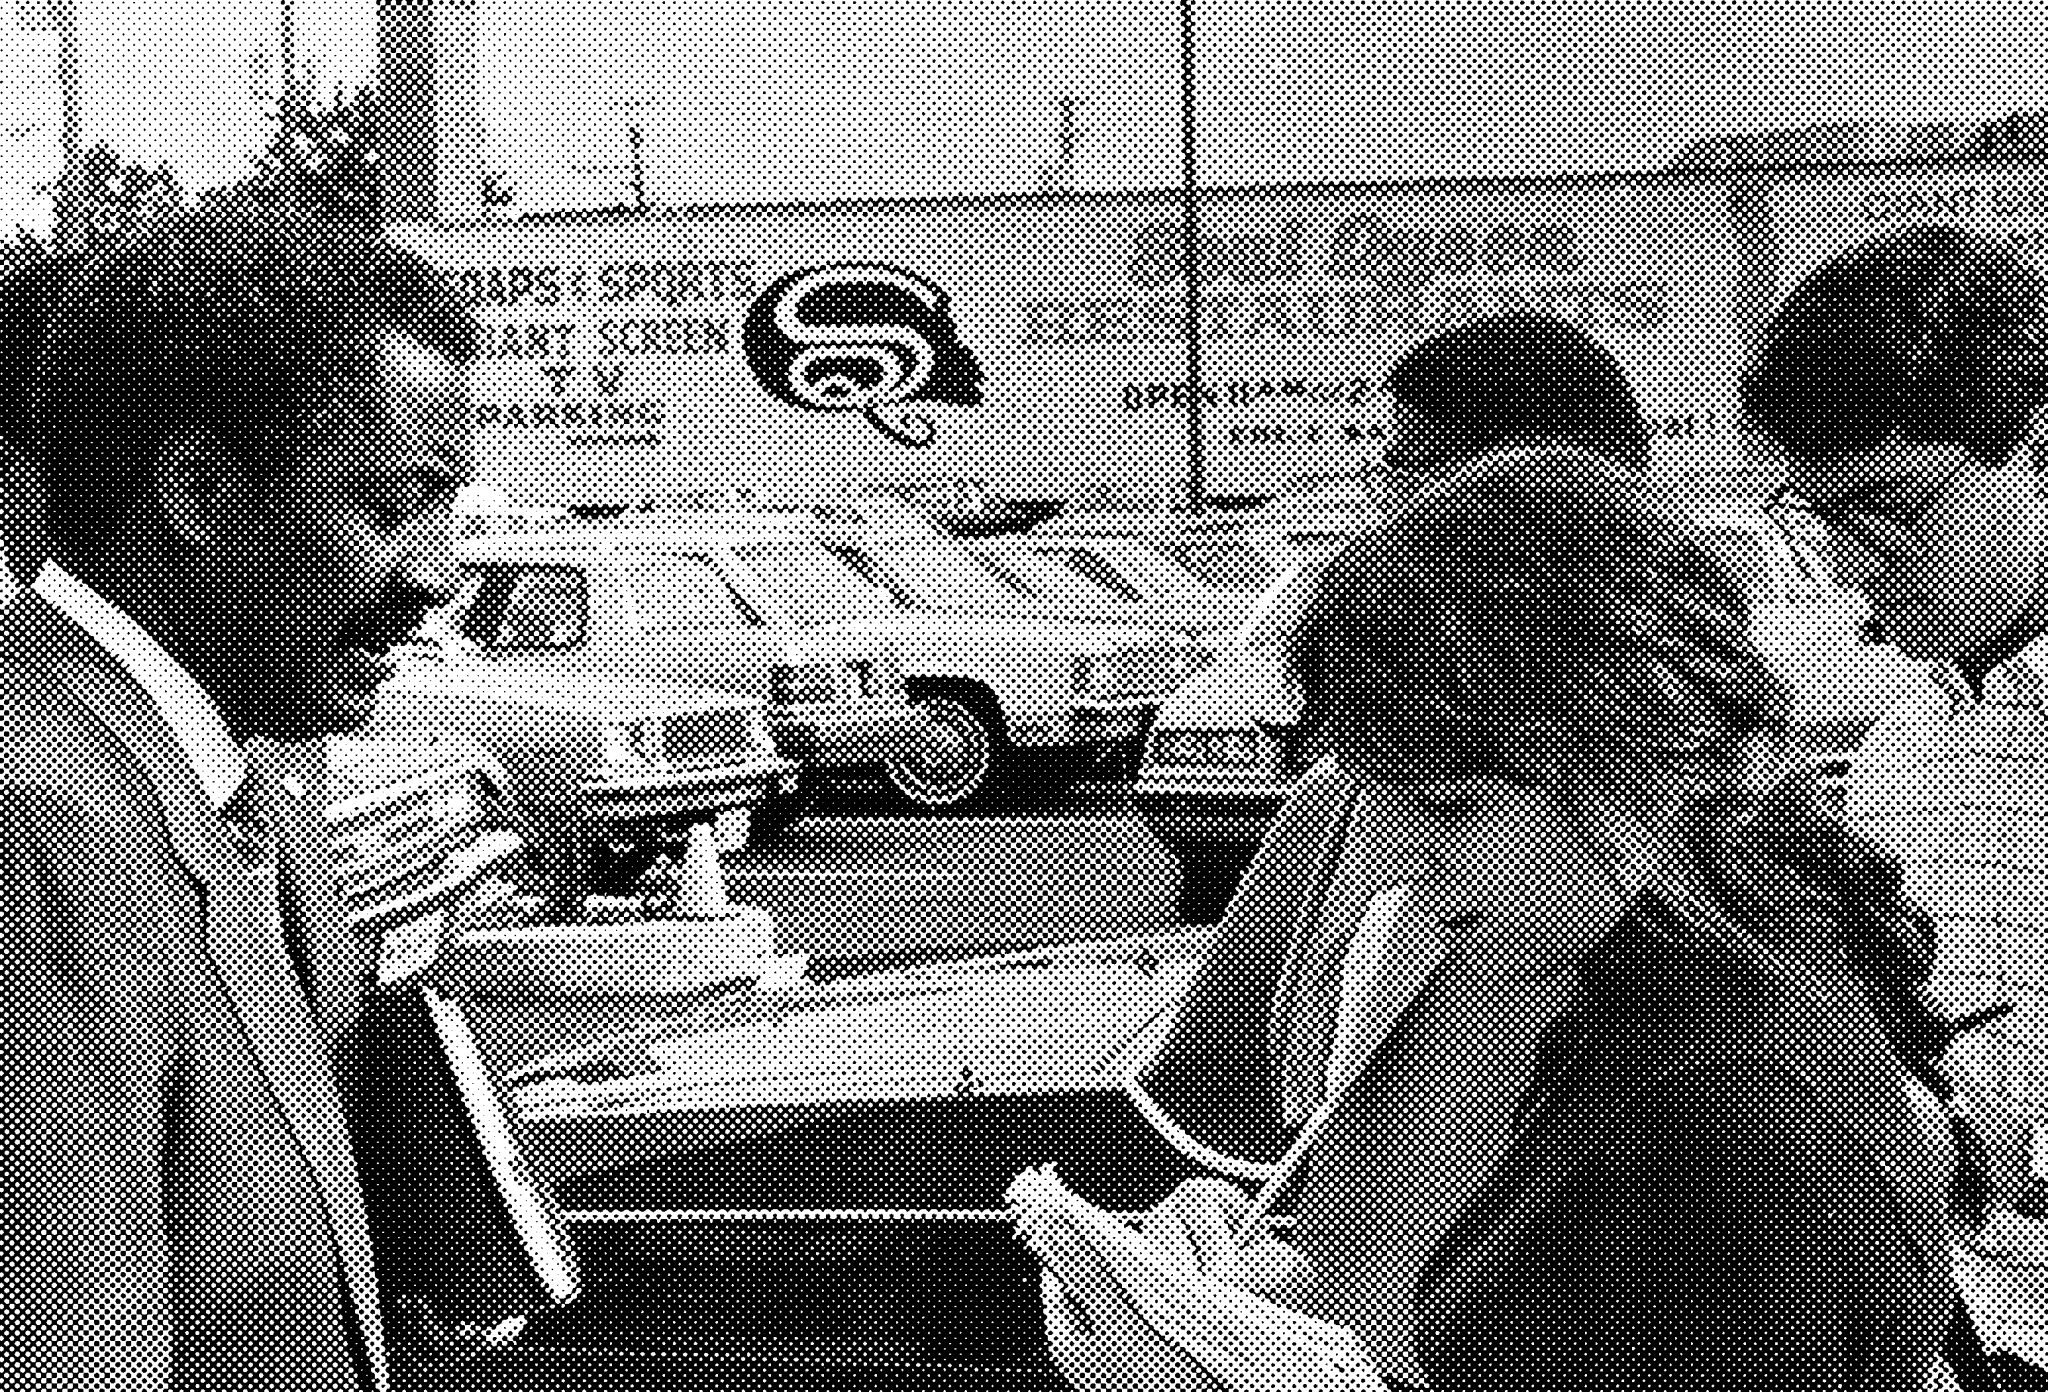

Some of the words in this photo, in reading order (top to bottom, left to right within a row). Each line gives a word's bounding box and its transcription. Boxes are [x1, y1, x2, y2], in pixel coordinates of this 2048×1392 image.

[1127, 218, 1304, 290] Soul
[1321, 211, 1586, 295] Queen
[472, 320, 574, 360] IANT
[598, 318, 728, 356] SCREEN
[476, 401, 665, 428] PARKING
[1122, 382, 1218, 412] OPEN
